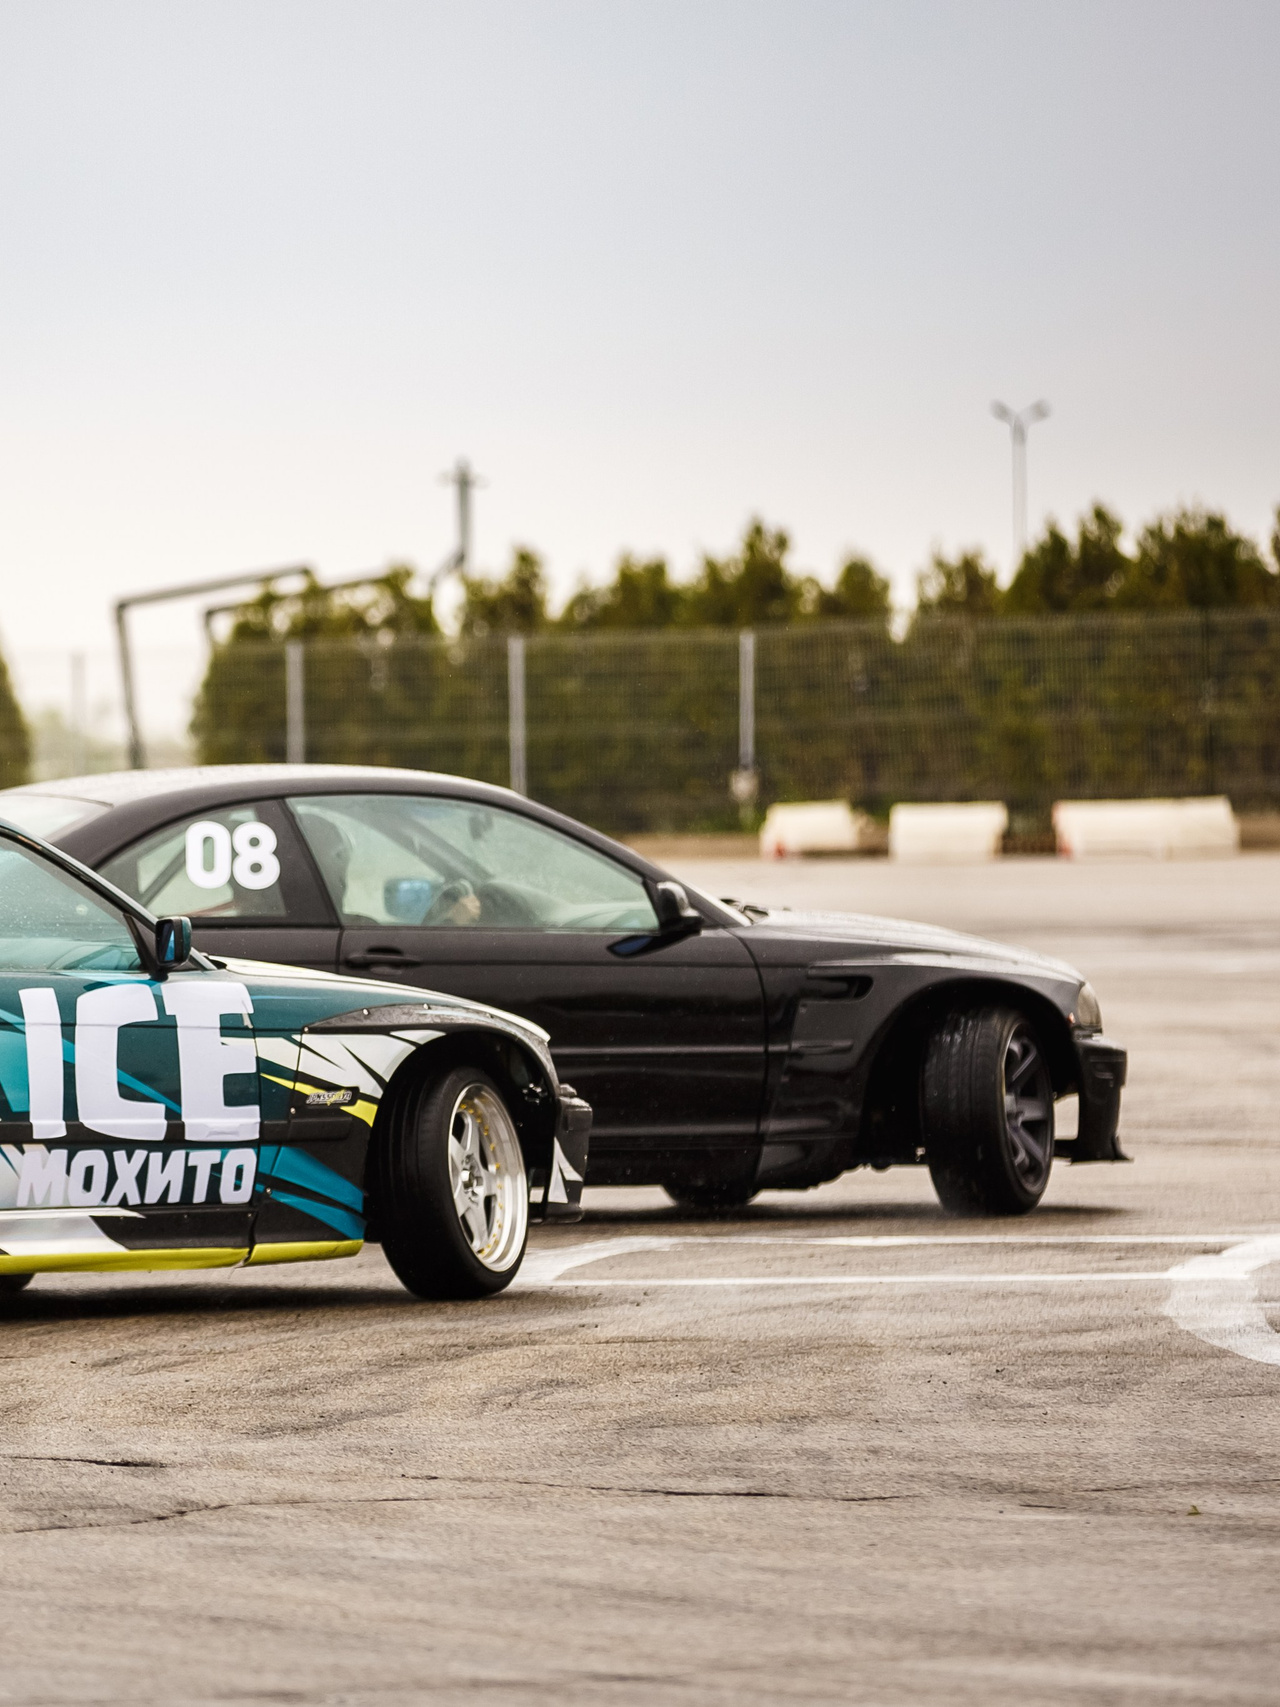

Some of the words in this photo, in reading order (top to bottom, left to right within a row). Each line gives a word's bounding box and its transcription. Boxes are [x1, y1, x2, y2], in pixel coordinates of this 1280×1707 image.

[185, 820, 281, 890] 08
[18, 981, 261, 1142] ICE
[16, 1148, 258, 1207] МОХИТО
